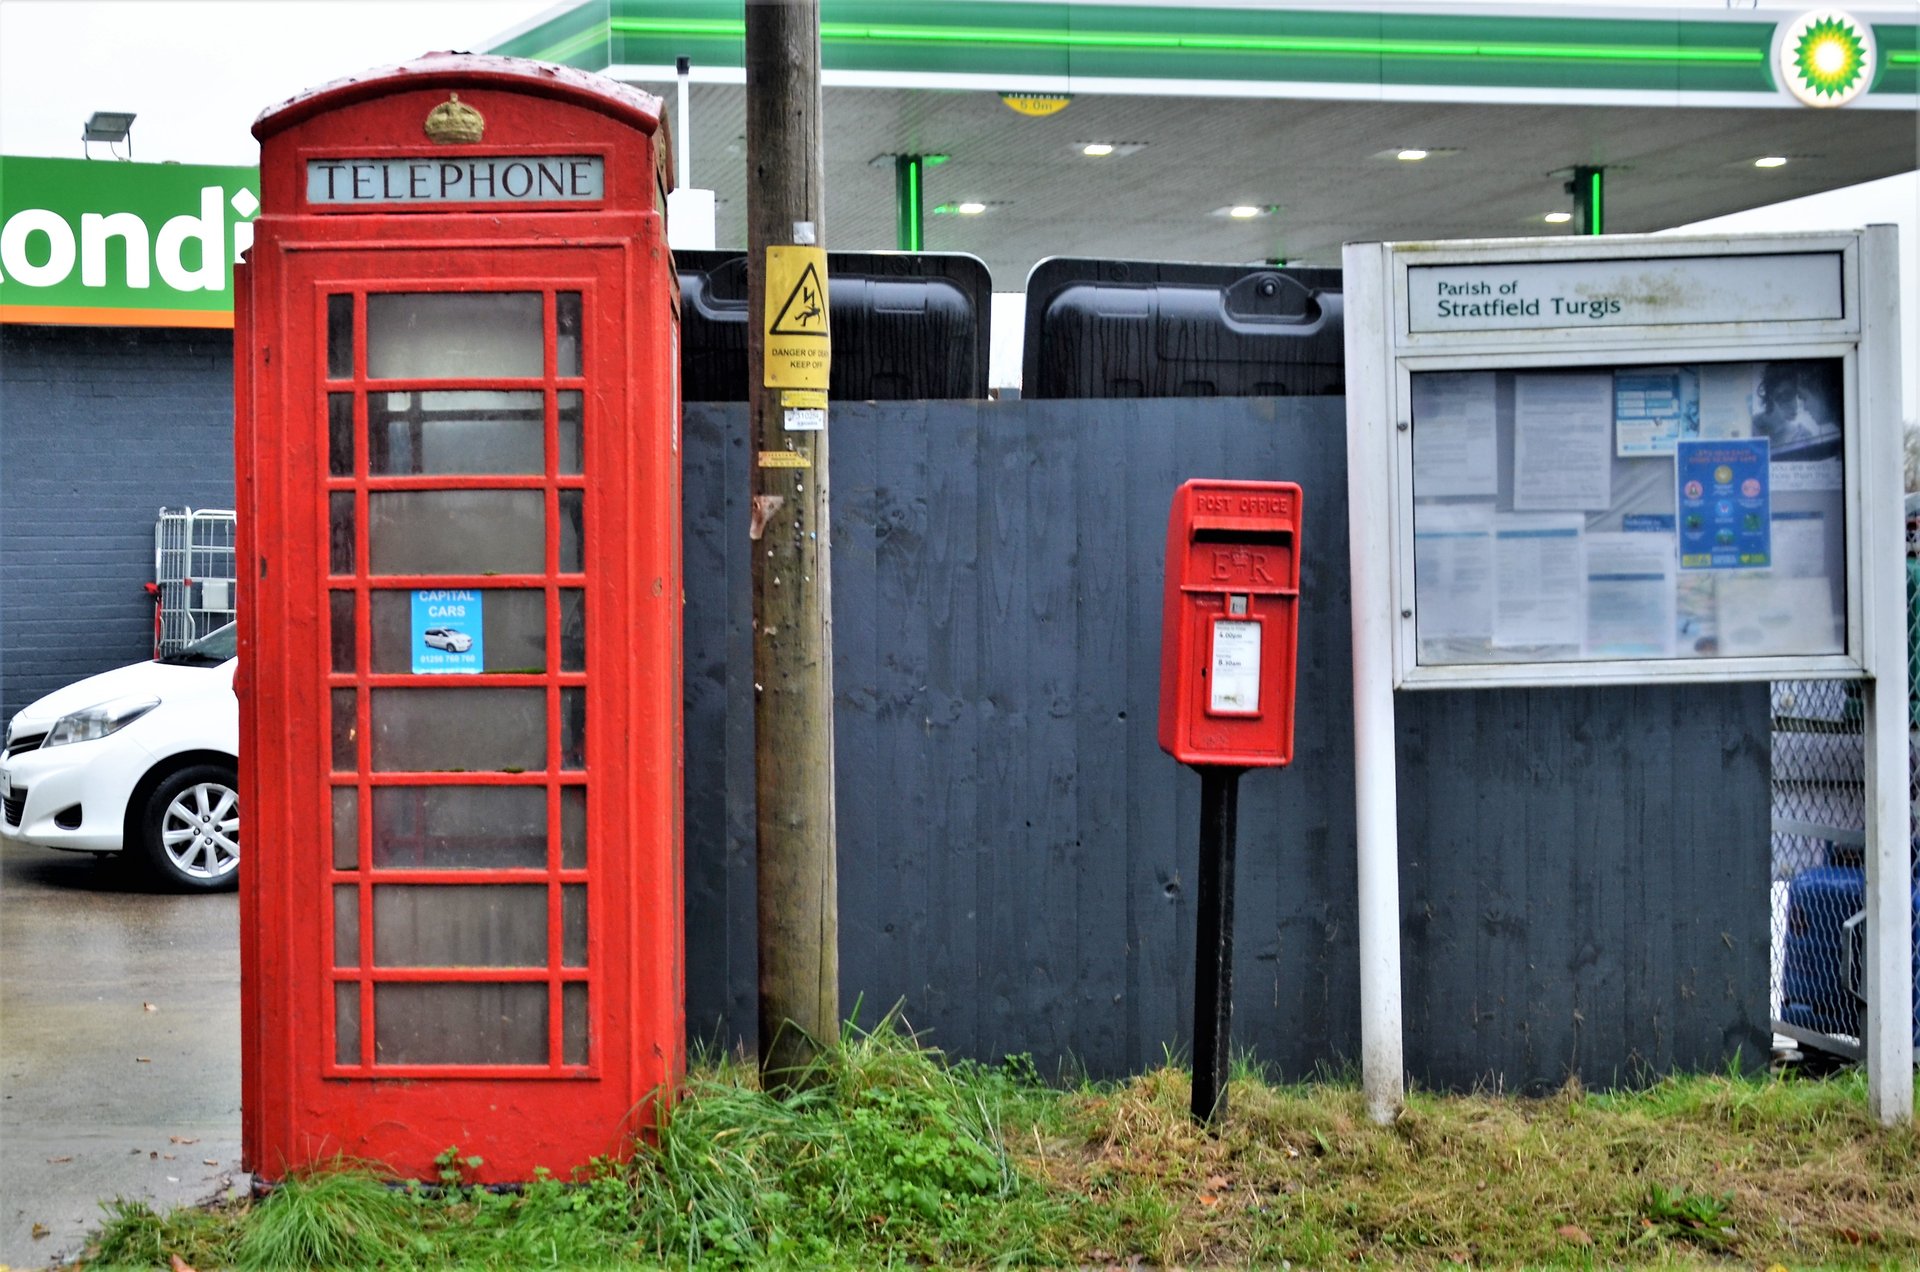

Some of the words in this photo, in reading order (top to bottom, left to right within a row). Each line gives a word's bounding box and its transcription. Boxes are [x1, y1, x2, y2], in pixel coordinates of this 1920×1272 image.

[317, 161, 593, 200] TELEPHONE
[0, 185, 260, 292] ondi
[1438, 281, 1491, 296] Parish
[1499, 280, 1518, 295] of
[1438, 298, 1540, 318] Stratfield
[1551, 297, 1621, 319] Turgis
[771, 348, 806, 357] DANGER
[807, 349, 816, 357] OF
[790, 360, 811, 369] KEEP
[1197, 495, 1232, 512] POST
[1240, 496, 1288, 514] OFFICE
[419, 590, 474, 602] CAPITAL
[428, 605, 466, 617] CARS
